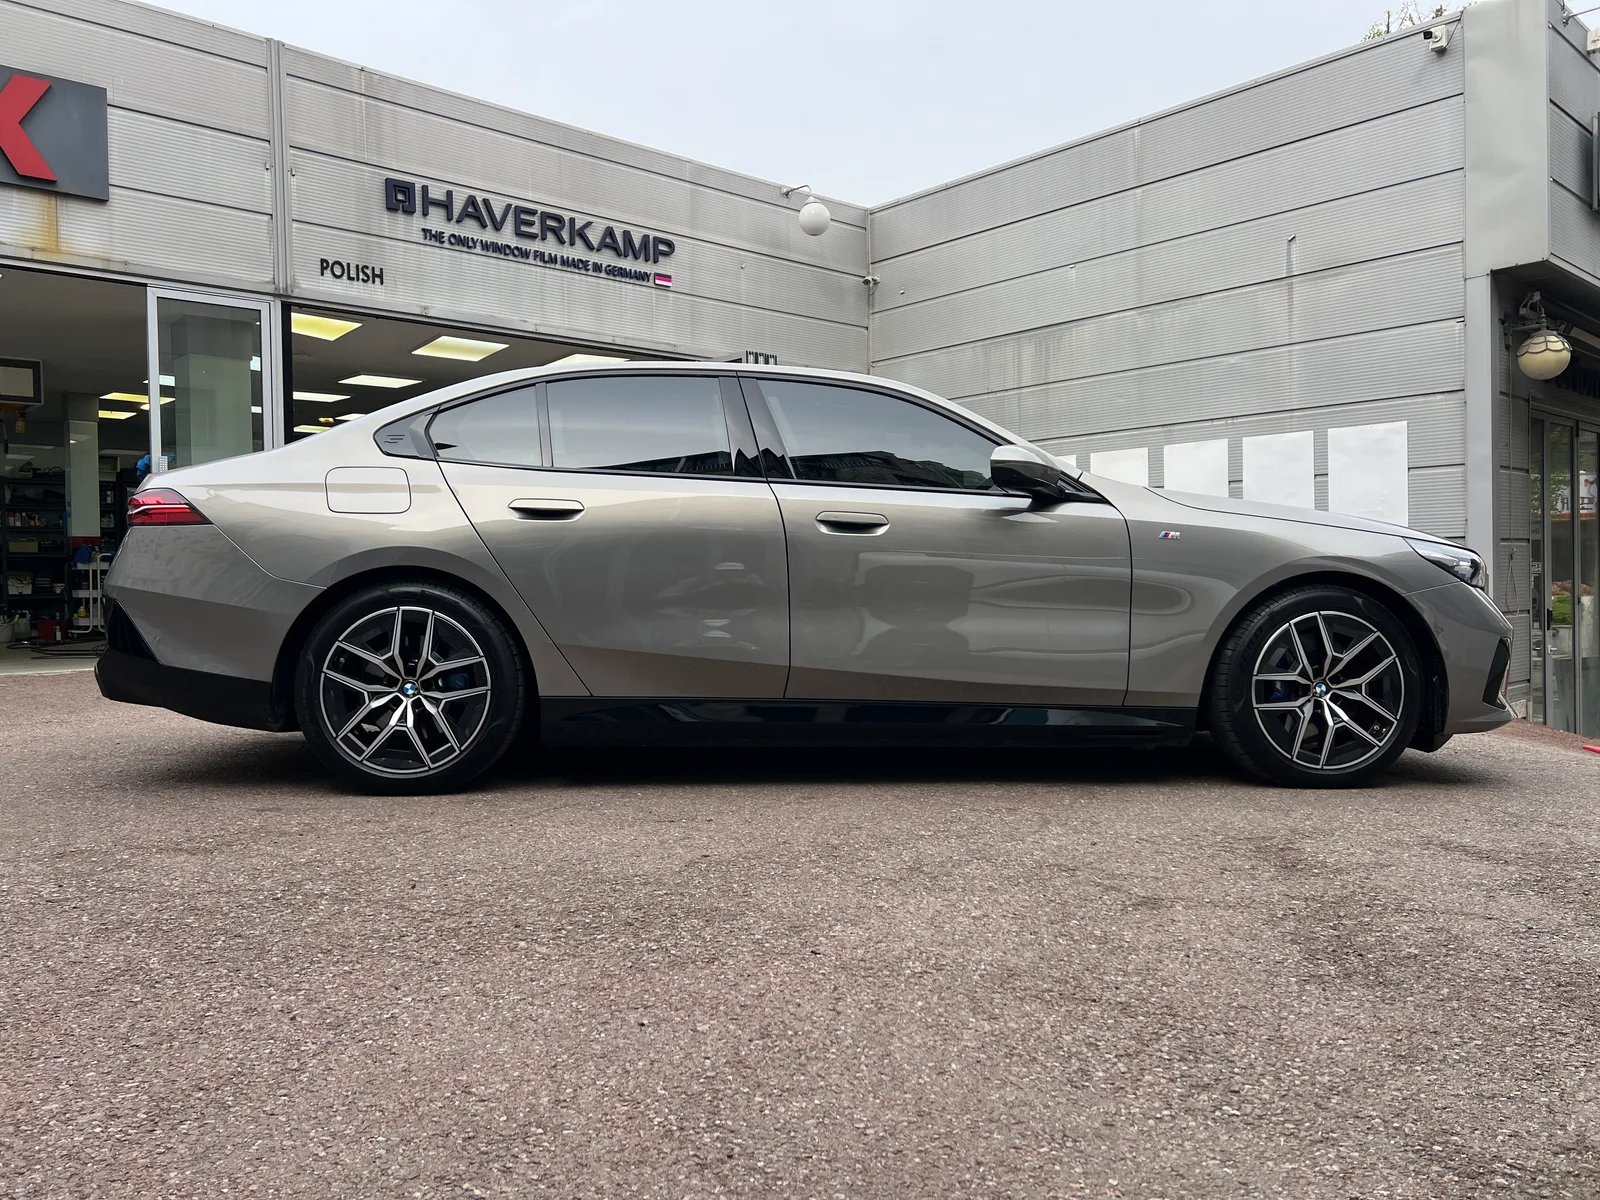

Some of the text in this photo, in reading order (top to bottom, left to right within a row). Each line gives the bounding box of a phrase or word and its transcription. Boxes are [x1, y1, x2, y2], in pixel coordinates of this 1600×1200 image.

[421, 184, 676, 264] HAVERKAMP
[320, 258, 384, 286] POLISH
[421, 228, 652, 282] THE ONLY WINDOW FILM MADE IN GERMANY
